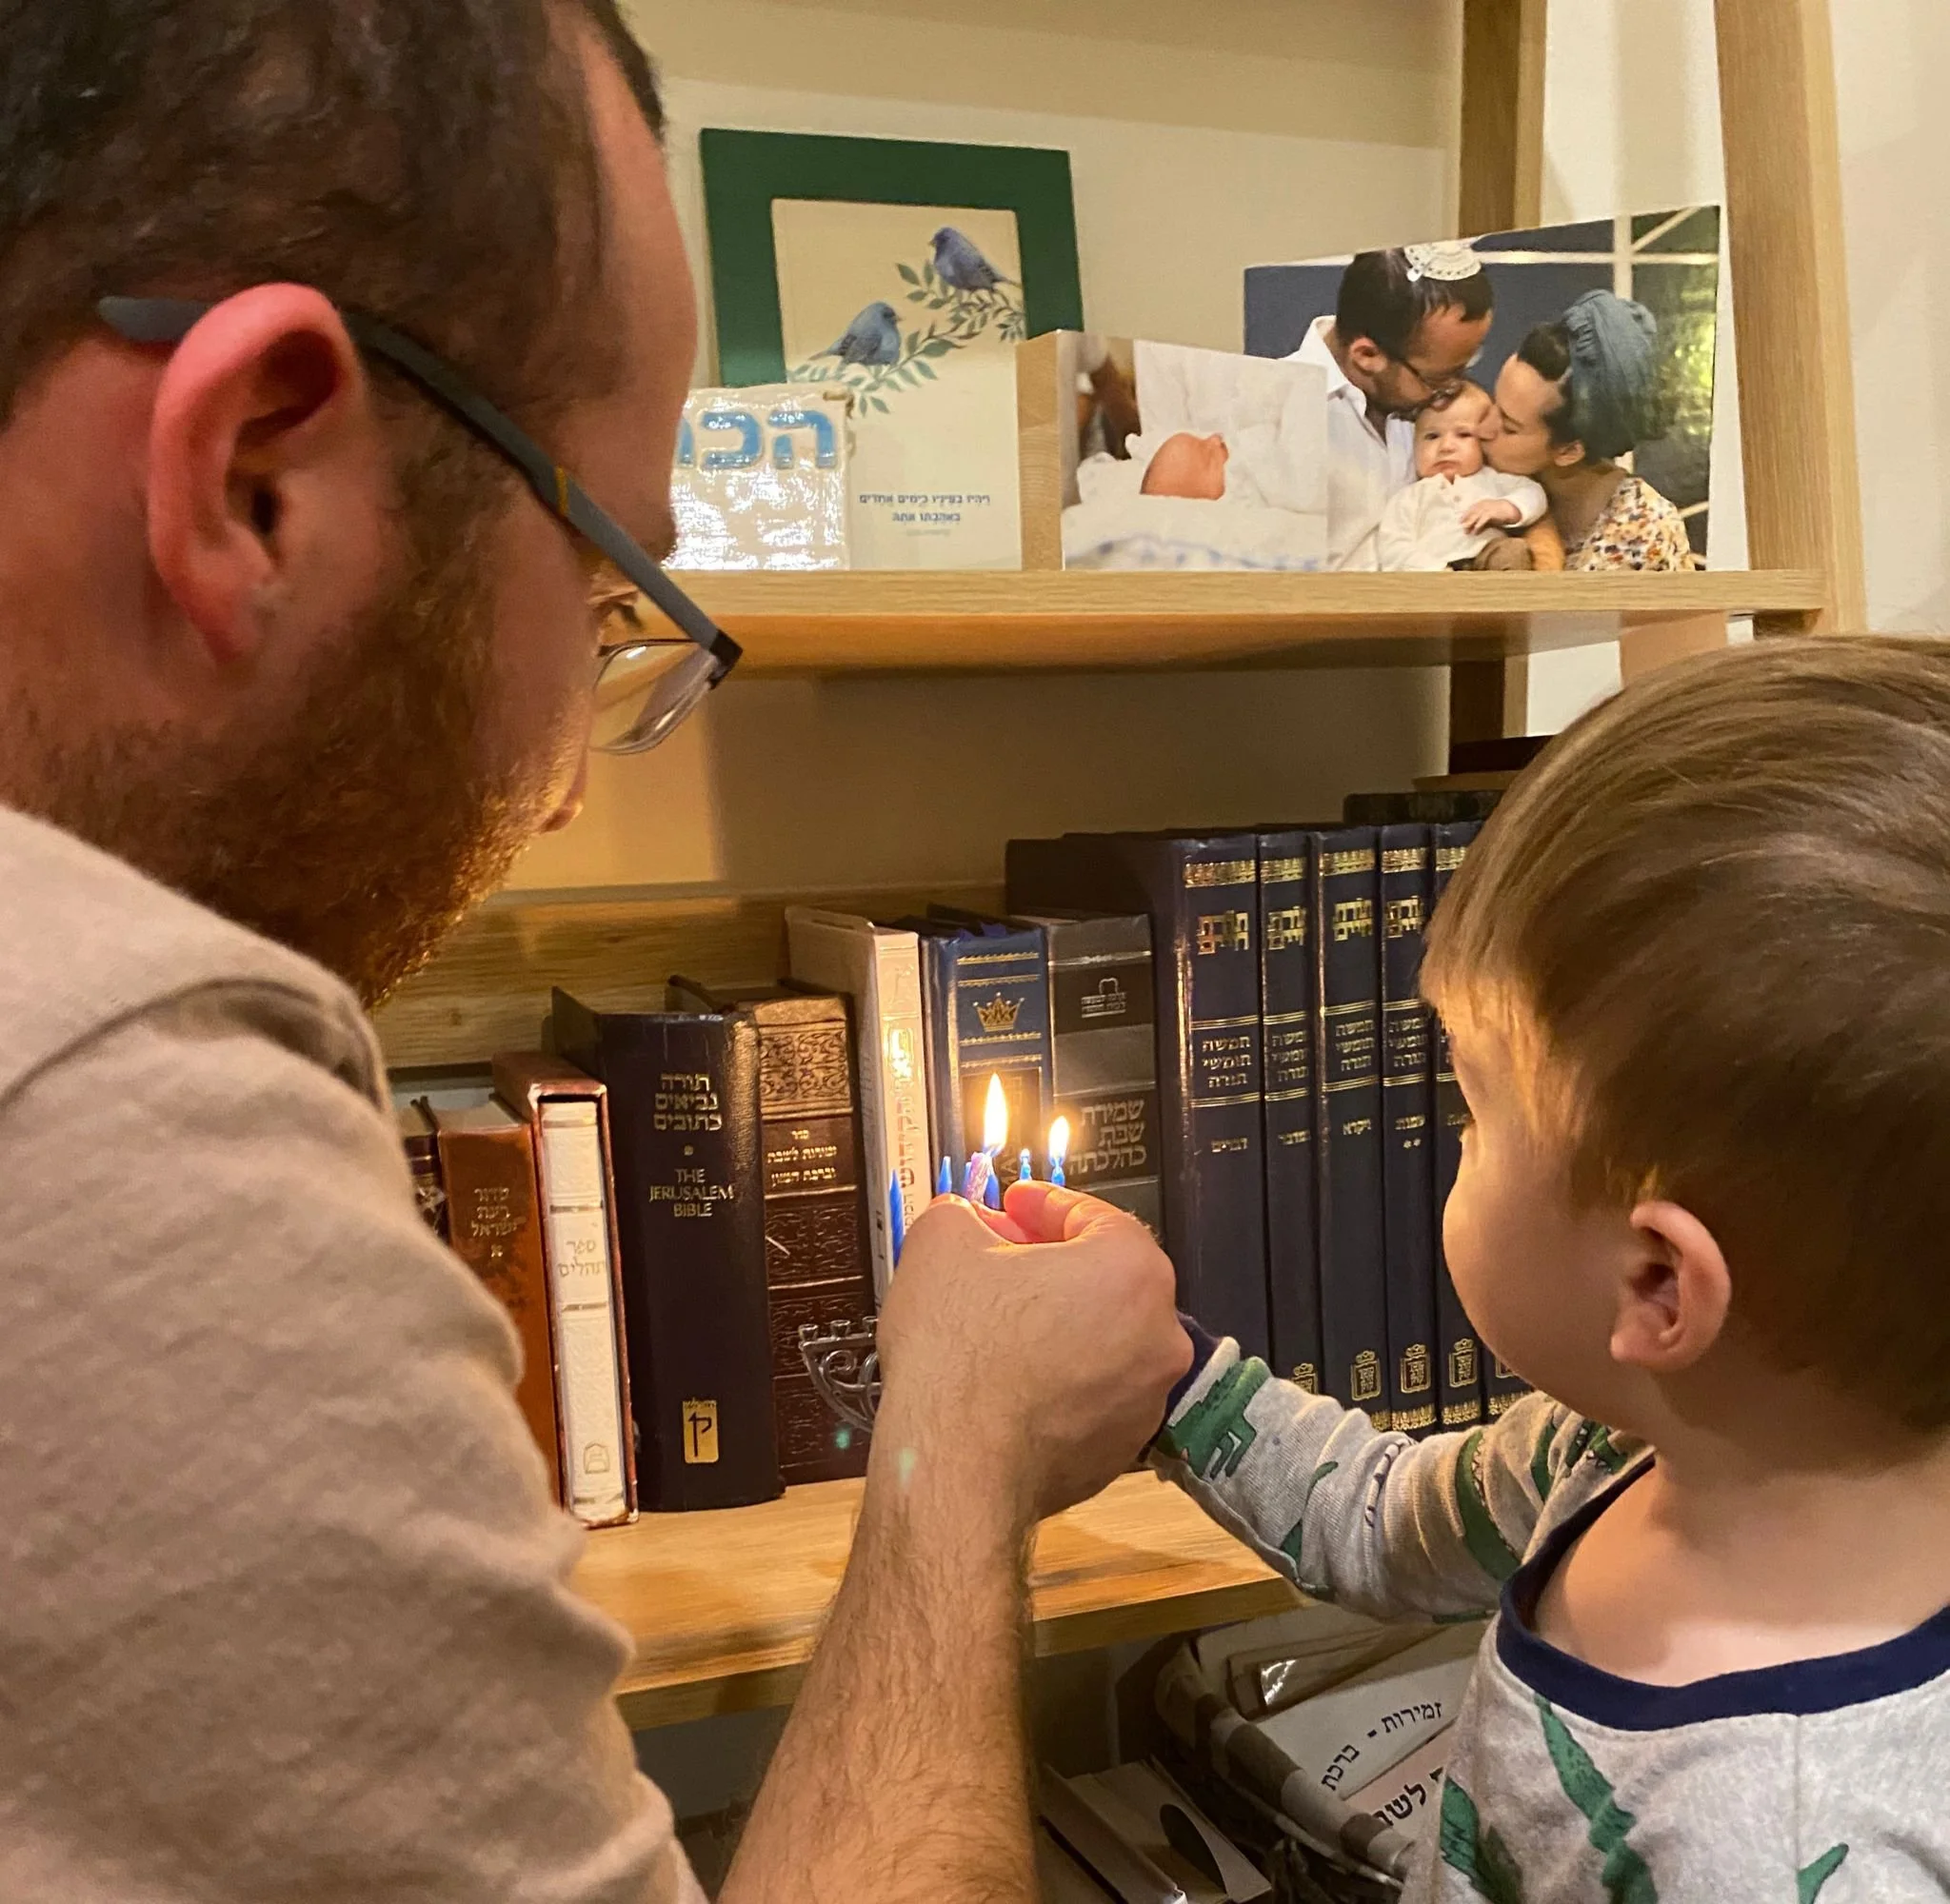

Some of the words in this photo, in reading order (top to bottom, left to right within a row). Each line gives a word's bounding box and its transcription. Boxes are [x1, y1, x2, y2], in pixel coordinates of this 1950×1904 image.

[1202, 1036, 1250, 1052] חמשה
[661, 1074, 711, 1091] תורה
[1207, 1073, 1248, 1088] תורה
[654, 1093, 719, 1111] נביאים
[653, 1113, 724, 1131] כתובים
[1098, 1121, 1144, 1147] שבת
[675, 1168, 706, 1183] THE
[649, 1185, 734, 1202] JERUSALEM
[673, 1202, 712, 1218] BIBLE
[557, 1257, 606, 1278] תהלים
[1382, 1701, 1442, 1734] זמירות
[1321, 1744, 1360, 1792] ברכת
